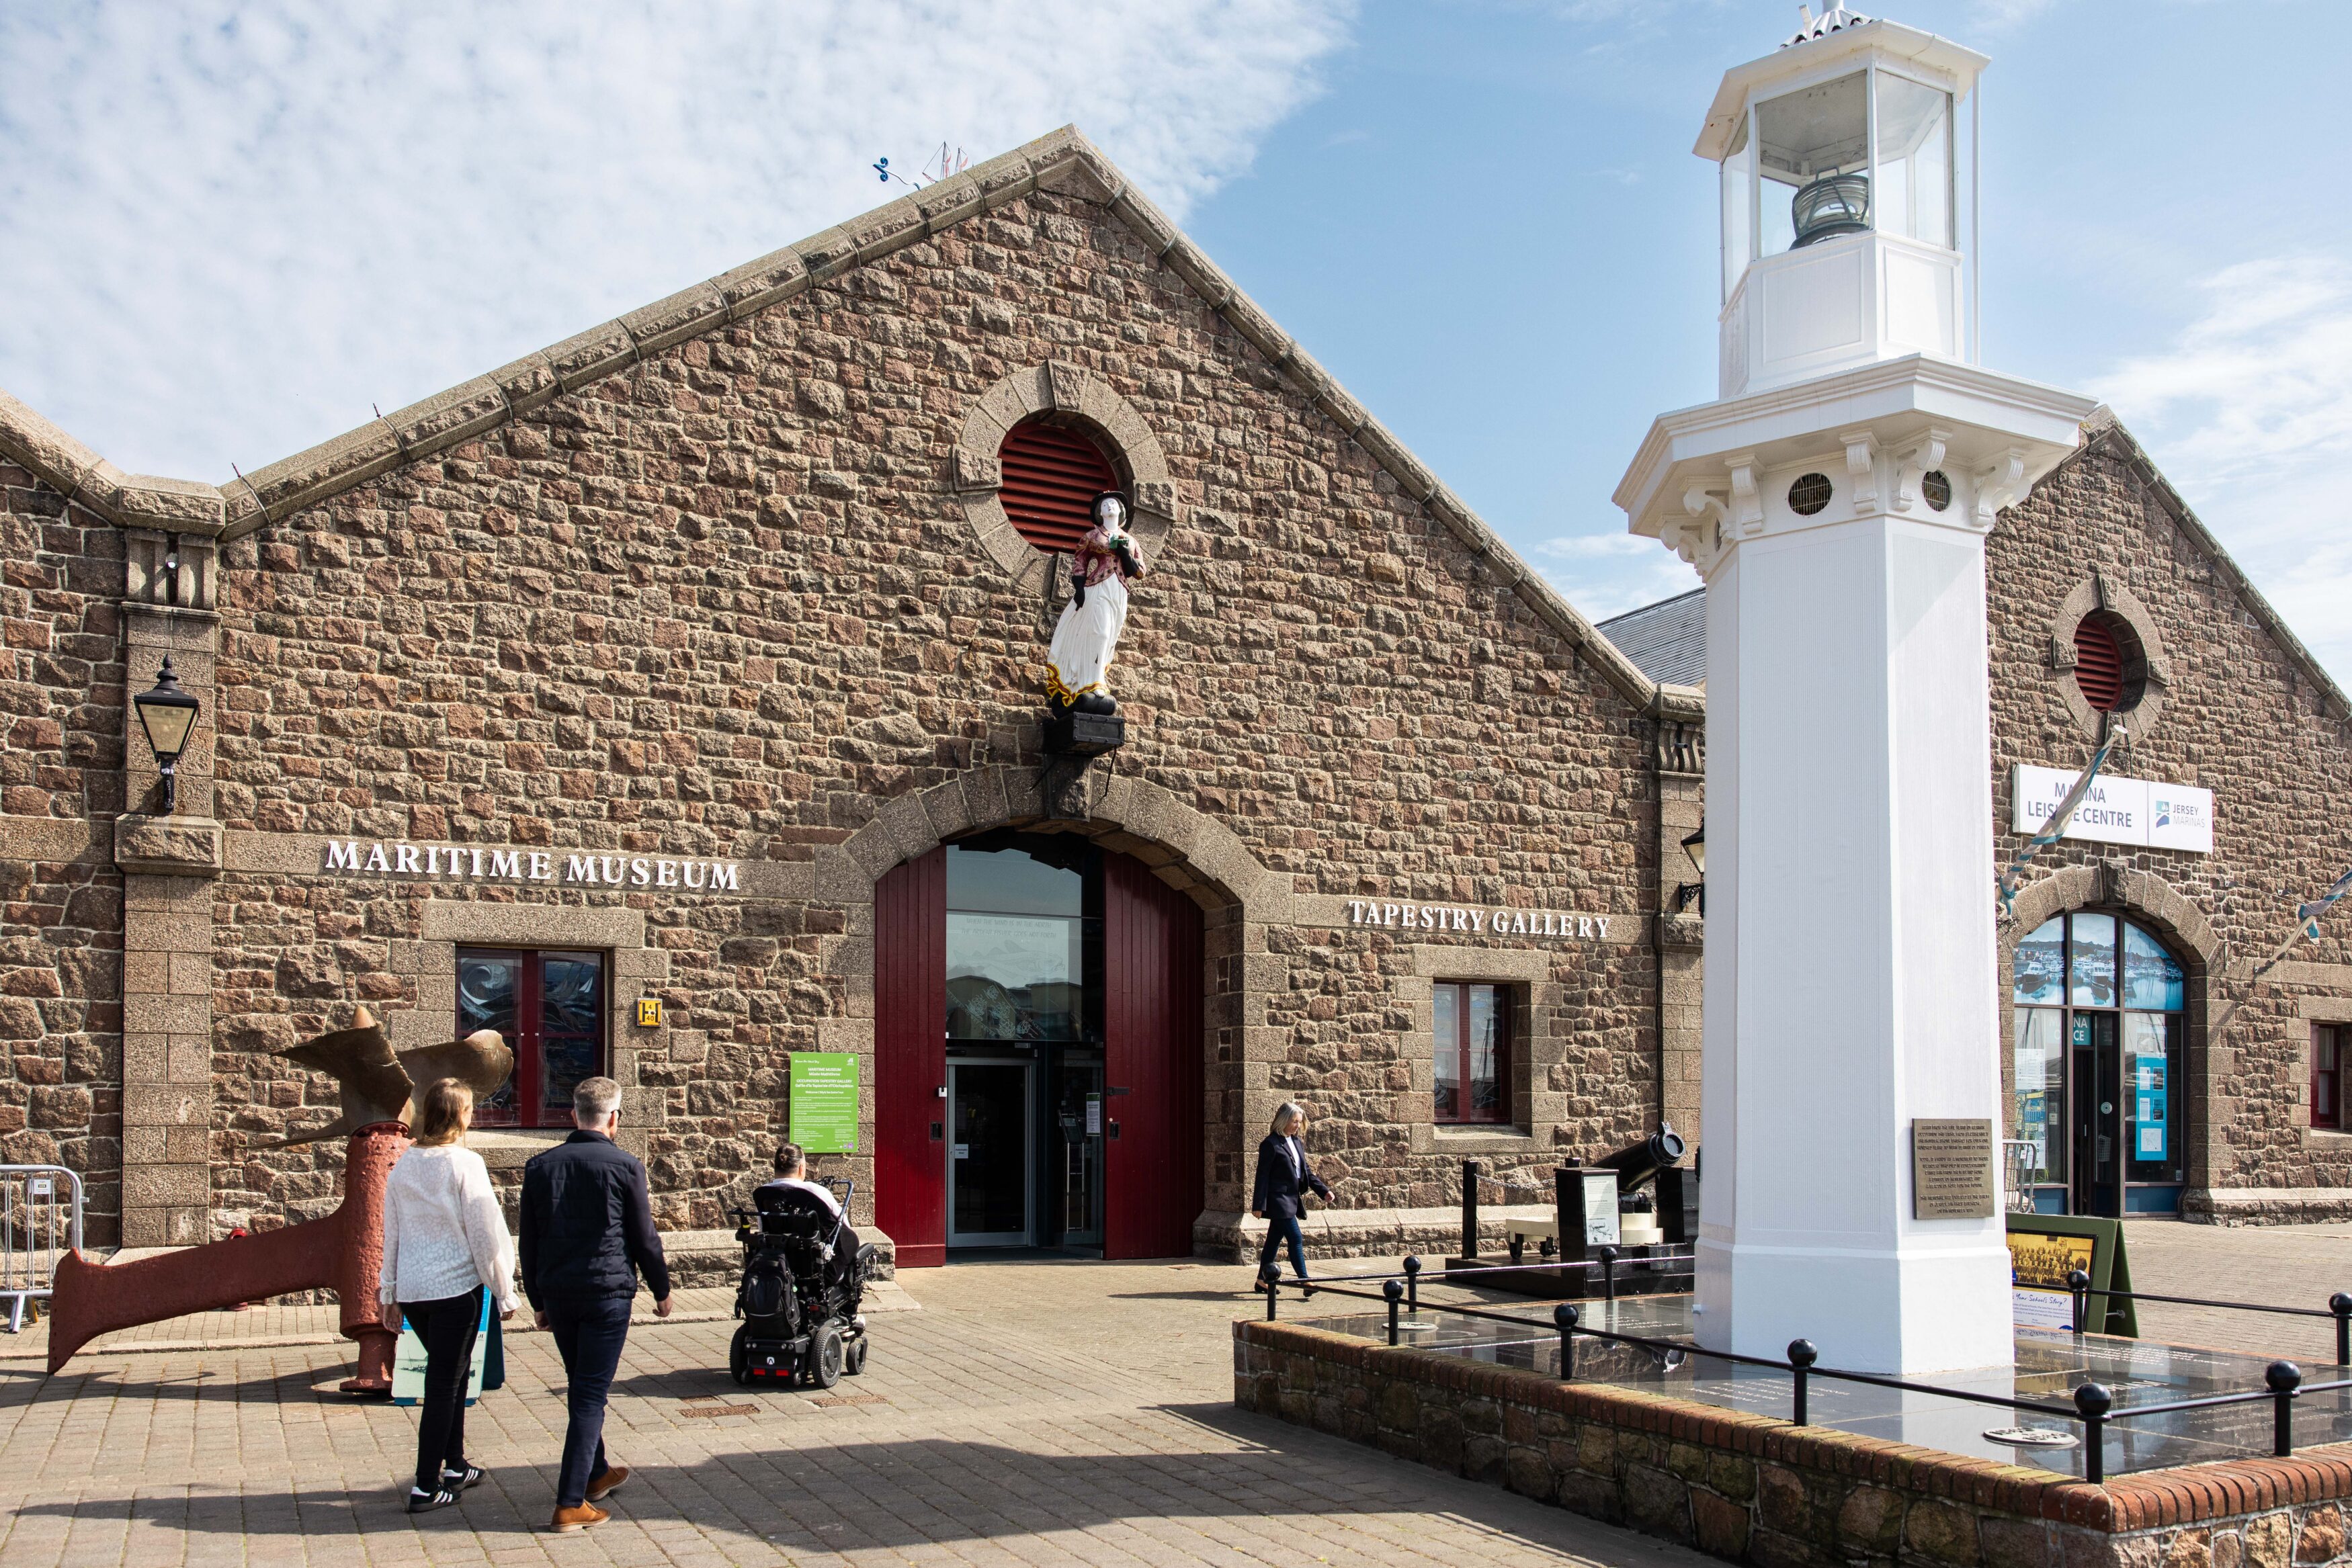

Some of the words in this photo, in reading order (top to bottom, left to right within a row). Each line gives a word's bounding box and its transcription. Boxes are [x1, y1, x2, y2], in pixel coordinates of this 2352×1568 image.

[2055, 782, 2106, 803] MAINA
[2028, 801, 2079, 822] LEISE
[2083, 808, 2132, 828] CENTRE
[2173, 804, 2199, 816] JERSEY
[2173, 814, 2205, 828] MARINAS
[325, 840, 552, 880] MARITIME
[566, 855, 739, 891] MUSEUM
[1349, 901, 1484, 932] TAPESTRY
[1493, 911, 1611, 938] GALLERY
[2029, 1295, 2048, 1303] School's
[2050, 1297, 2067, 1307] Story?
